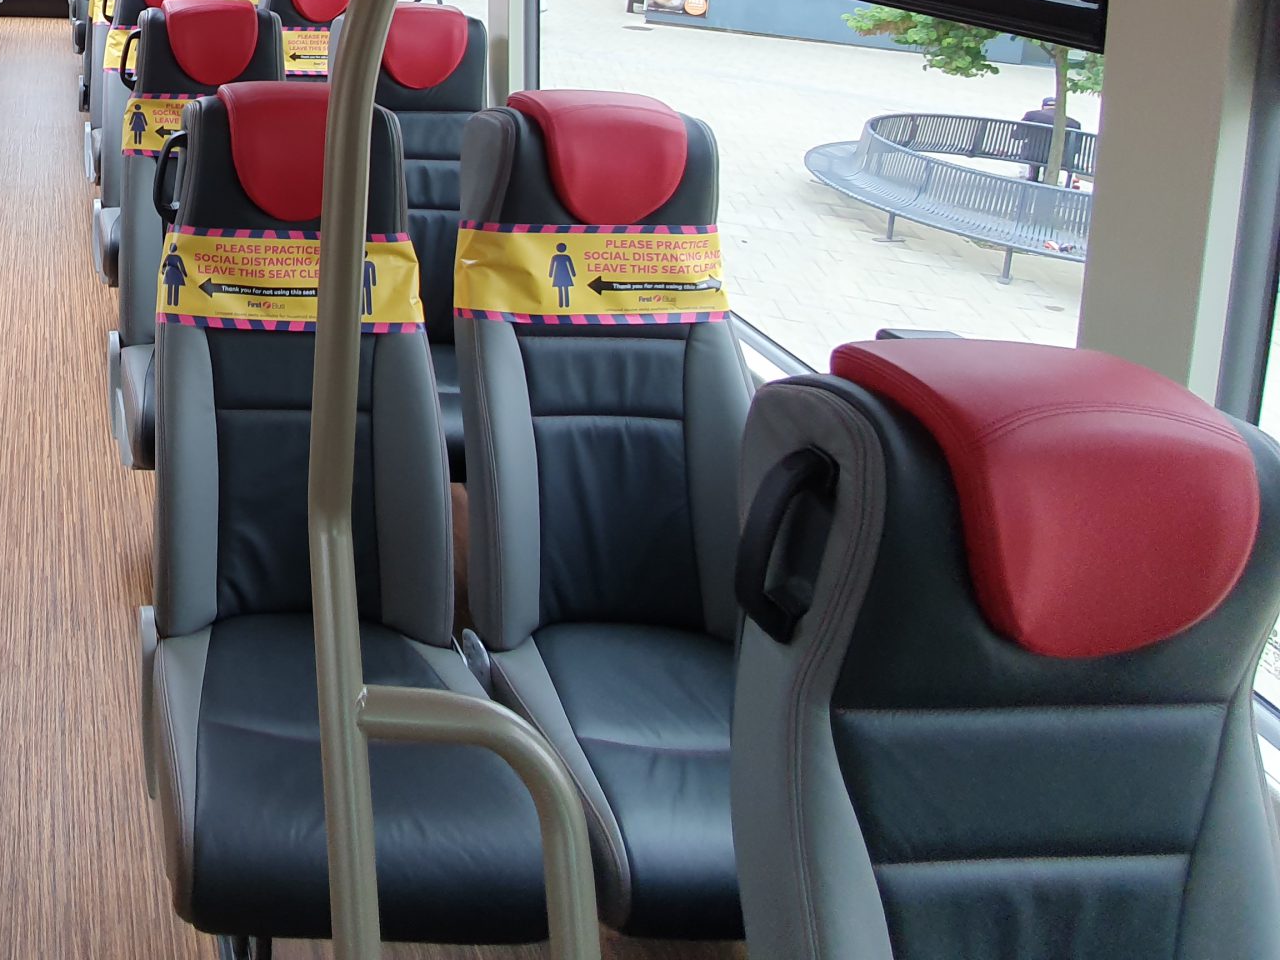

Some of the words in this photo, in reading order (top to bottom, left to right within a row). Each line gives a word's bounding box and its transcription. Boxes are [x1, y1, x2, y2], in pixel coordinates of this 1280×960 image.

[215, 243, 262, 254] PLEASE
[264, 245, 320, 255] PRACTICE
[606, 239, 654, 250] PLEASE
[656, 239, 710, 251] PRACTICE
[194, 252, 239, 265] SOCIAL
[241, 255, 312, 267] DISTANCING
[583, 250, 630, 261] SOCIAL
[632, 250, 703, 262] DISTANCING
[197, 264, 236, 276] LEAVE
[238, 267, 266, 279] THIS
[268, 269, 296, 279] SEAT
[299, 269, 320, 279] CLE
[587, 262, 628, 273] LEAVE
[630, 263, 659, 274] THIS
[661, 263, 691, 275] SEAT
[247, 300, 262, 308] First
